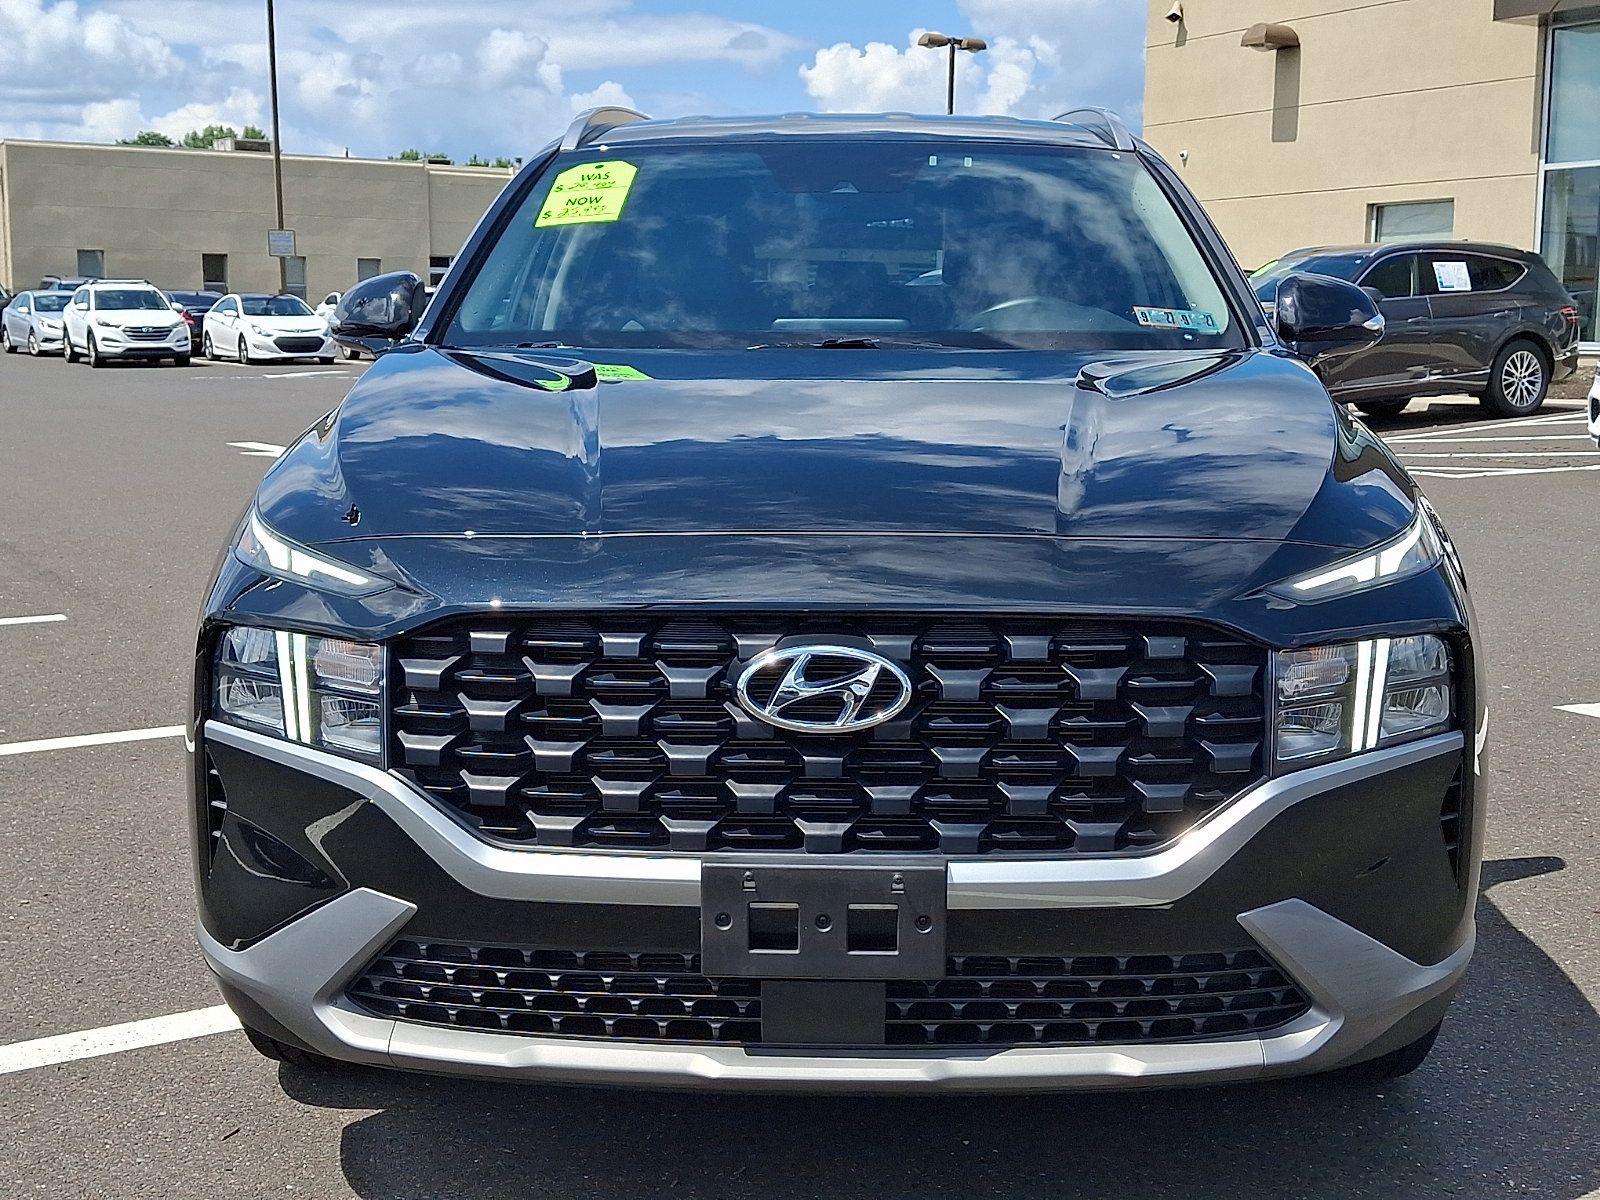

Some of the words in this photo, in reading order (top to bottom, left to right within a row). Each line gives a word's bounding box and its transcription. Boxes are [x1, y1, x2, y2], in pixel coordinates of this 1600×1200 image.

[581, 172, 610, 182] WAS
[554, 185, 564, 193] $
[566, 196, 604, 206] NOW
[542, 211, 552, 219] $
[1139, 312, 1149, 323] 9
[1181, 315, 1190, 325] 9
